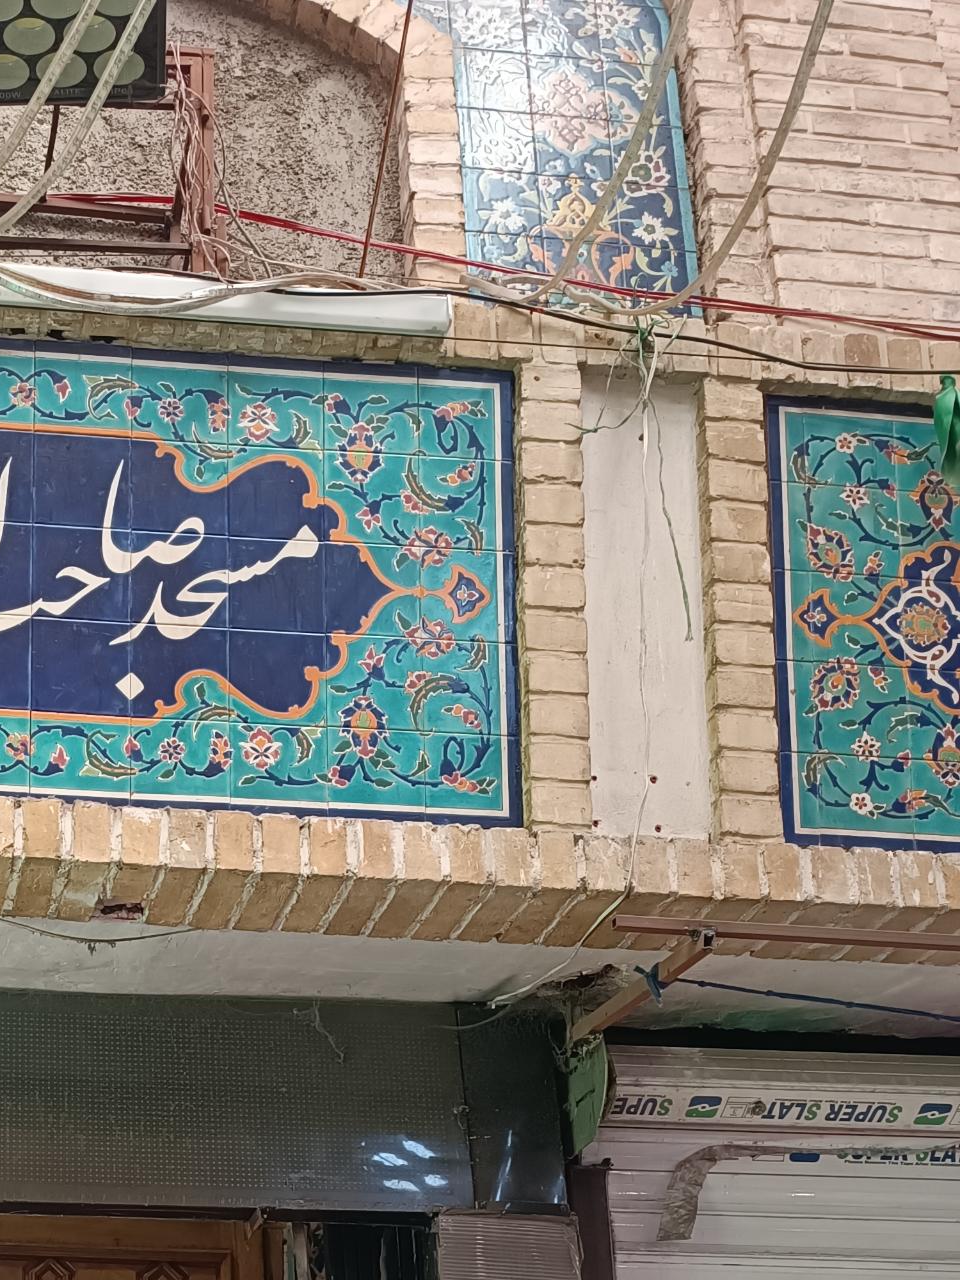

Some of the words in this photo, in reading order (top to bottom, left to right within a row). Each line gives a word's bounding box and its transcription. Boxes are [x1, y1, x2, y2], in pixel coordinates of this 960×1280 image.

[109, 523, 320, 699] مسجد
[611, 1097, 674, 1117] SUPE
[760, 1101, 822, 1121] SLAT
[825, 1104, 903, 1124] SUPER
